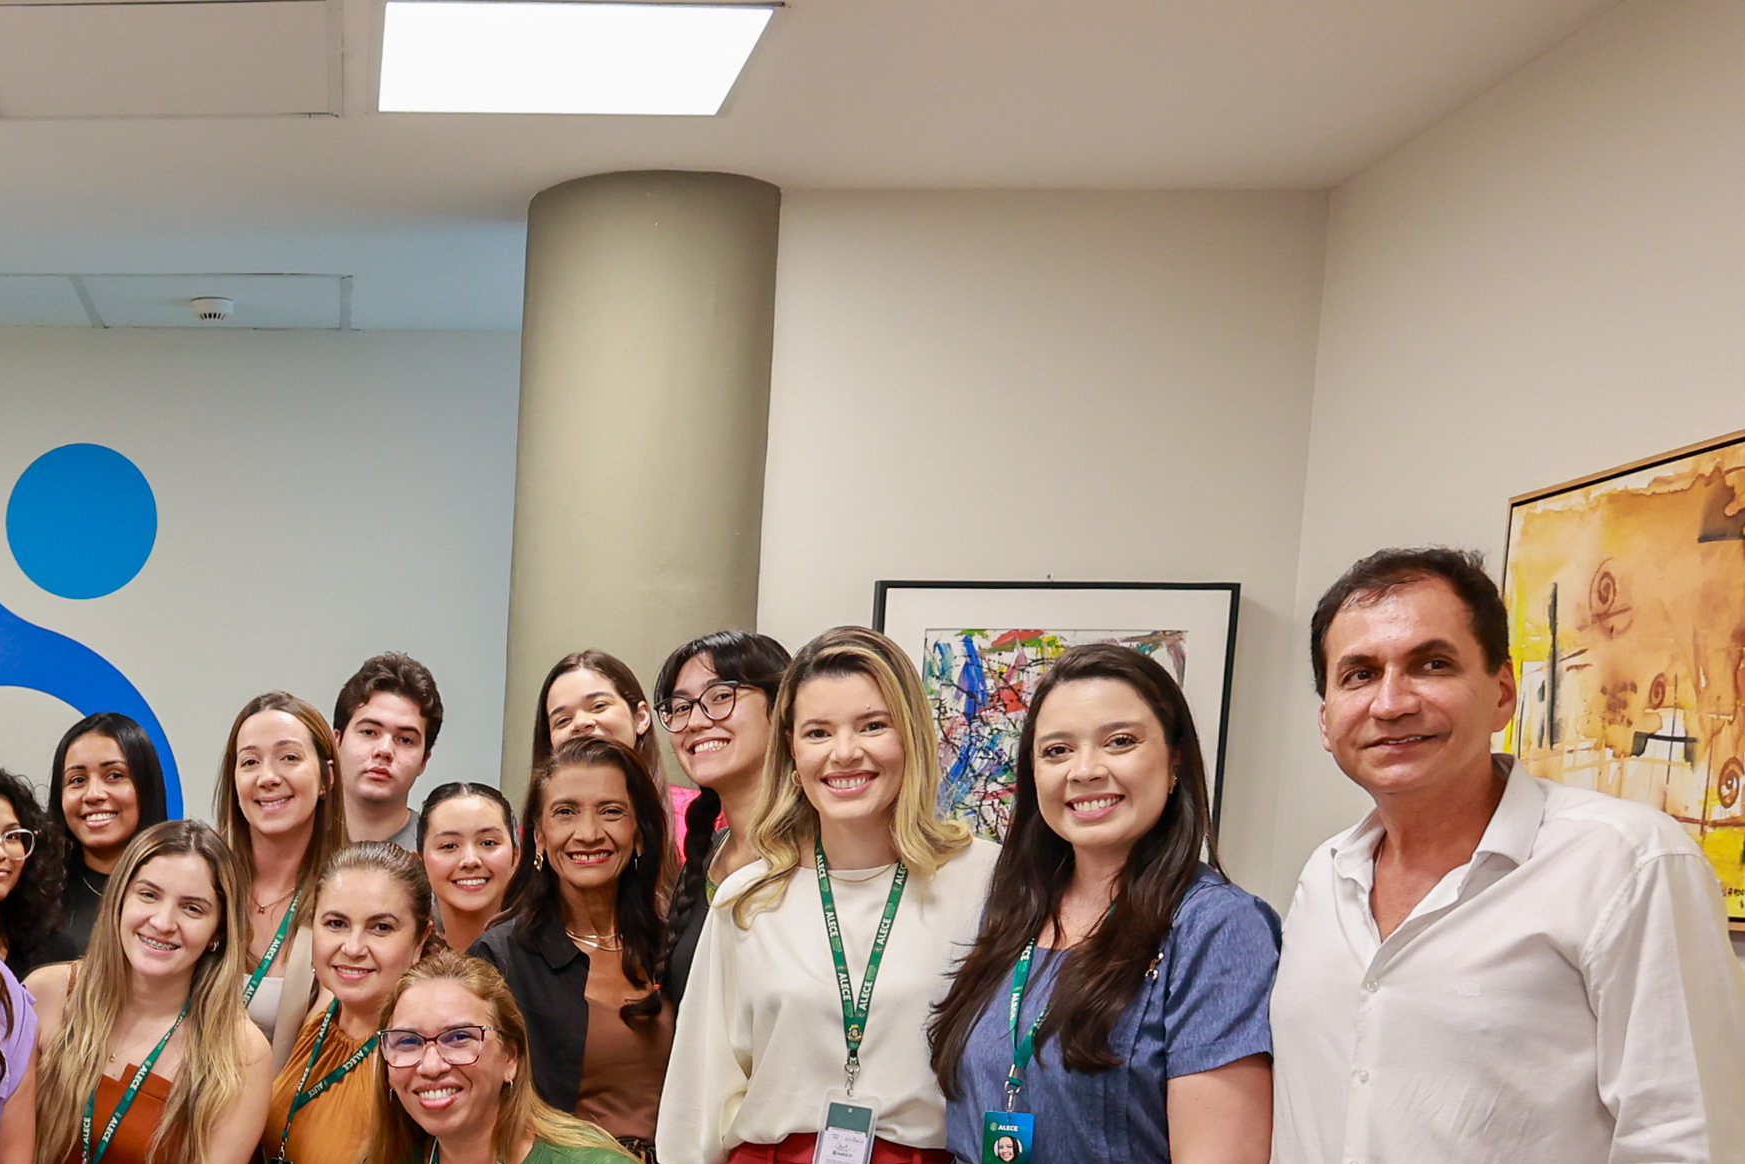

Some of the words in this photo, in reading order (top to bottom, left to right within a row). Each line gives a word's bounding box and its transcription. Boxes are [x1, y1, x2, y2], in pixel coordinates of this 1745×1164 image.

[816, 854, 827, 880] ALECE
[895, 862, 907, 886] ALEC
[825, 911, 839, 938] ALECE
[876, 917, 892, 946] ALECE
[265, 938, 282, 961] ALECE
[837, 972, 852, 1001] ALECE
[858, 980, 873, 1011] ALECE
[318, 1012, 332, 1038] ALECE
[342, 1049, 365, 1071] ALECE
[130, 1065, 149, 1091] ALECE
[82, 1116, 91, 1144] ALECE
[101, 1116, 119, 1143] ALECE
[998, 1124, 1019, 1132] ALECE
